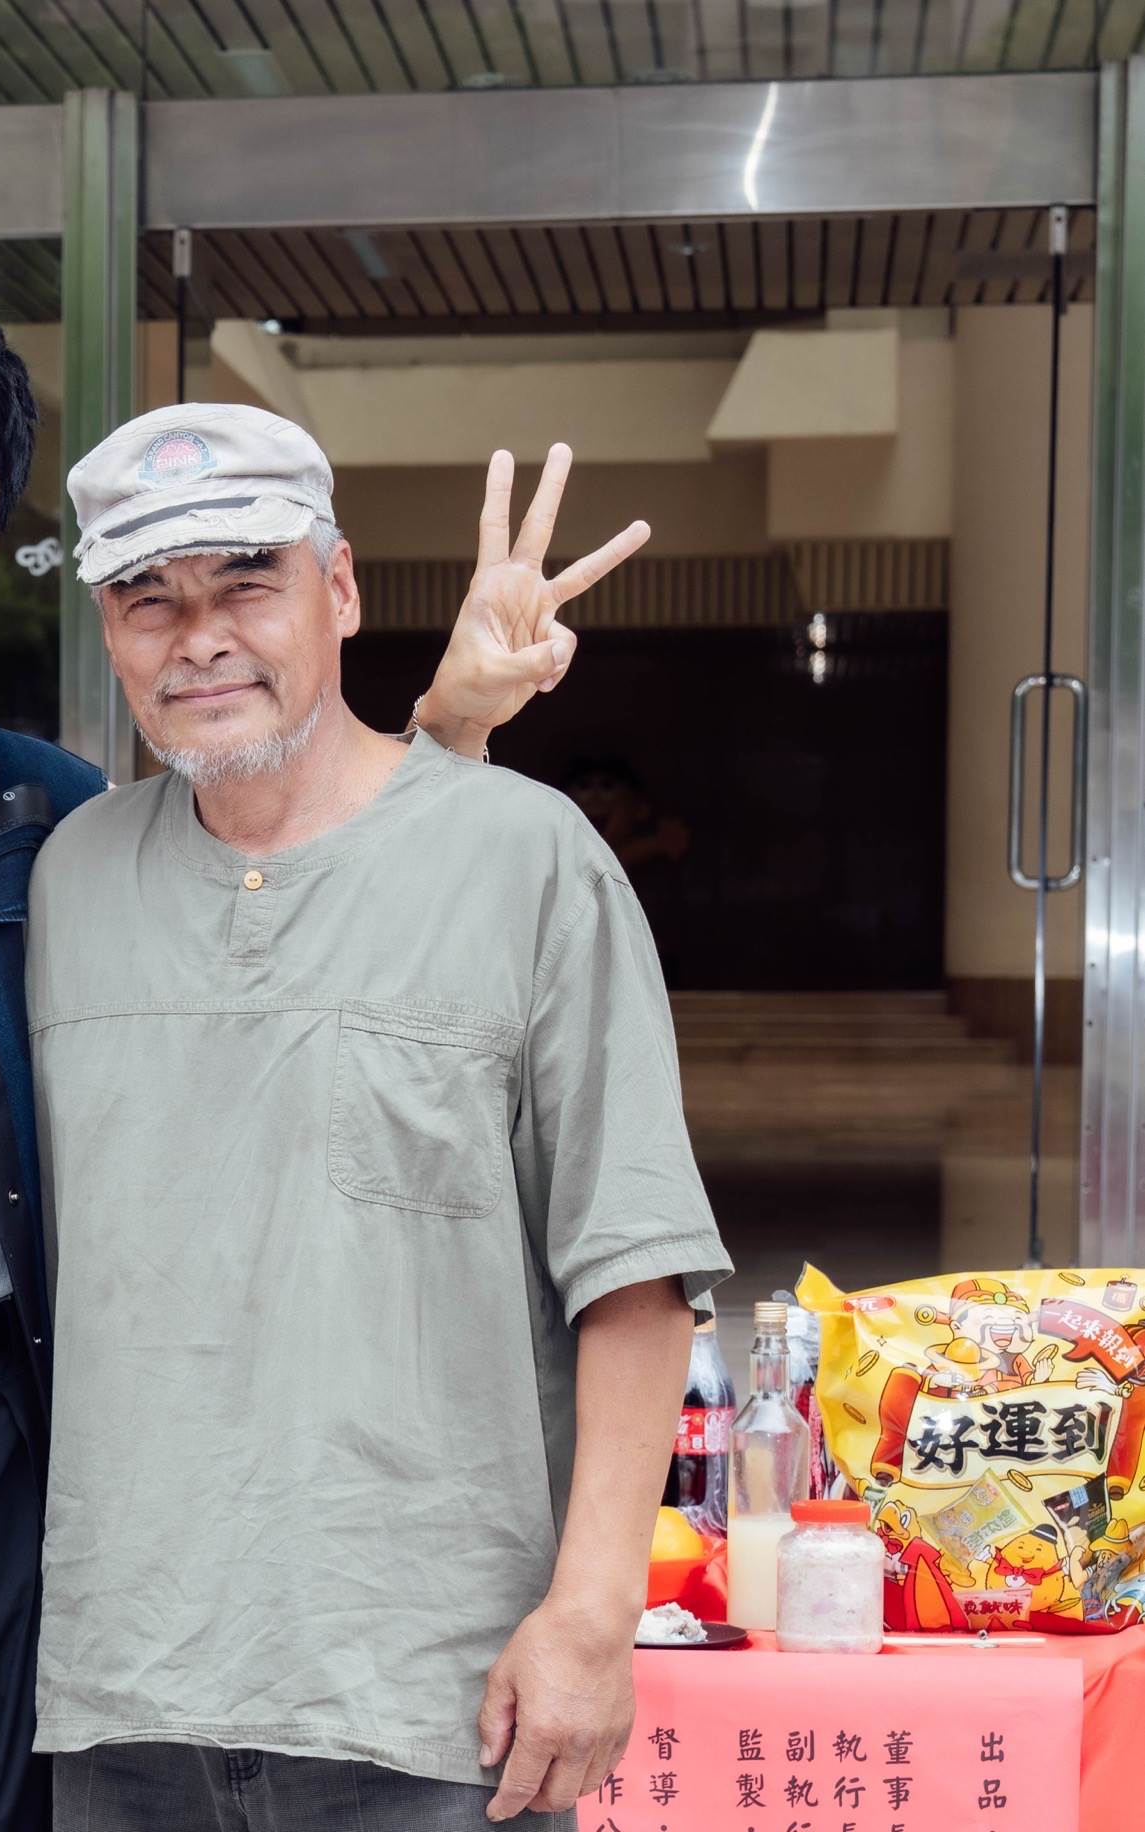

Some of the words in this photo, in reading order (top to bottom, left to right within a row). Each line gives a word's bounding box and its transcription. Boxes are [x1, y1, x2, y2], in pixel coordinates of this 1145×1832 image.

[1044, 1308, 1136, 1370] 一起來報到
[907, 1400, 1114, 1477] 好運到
